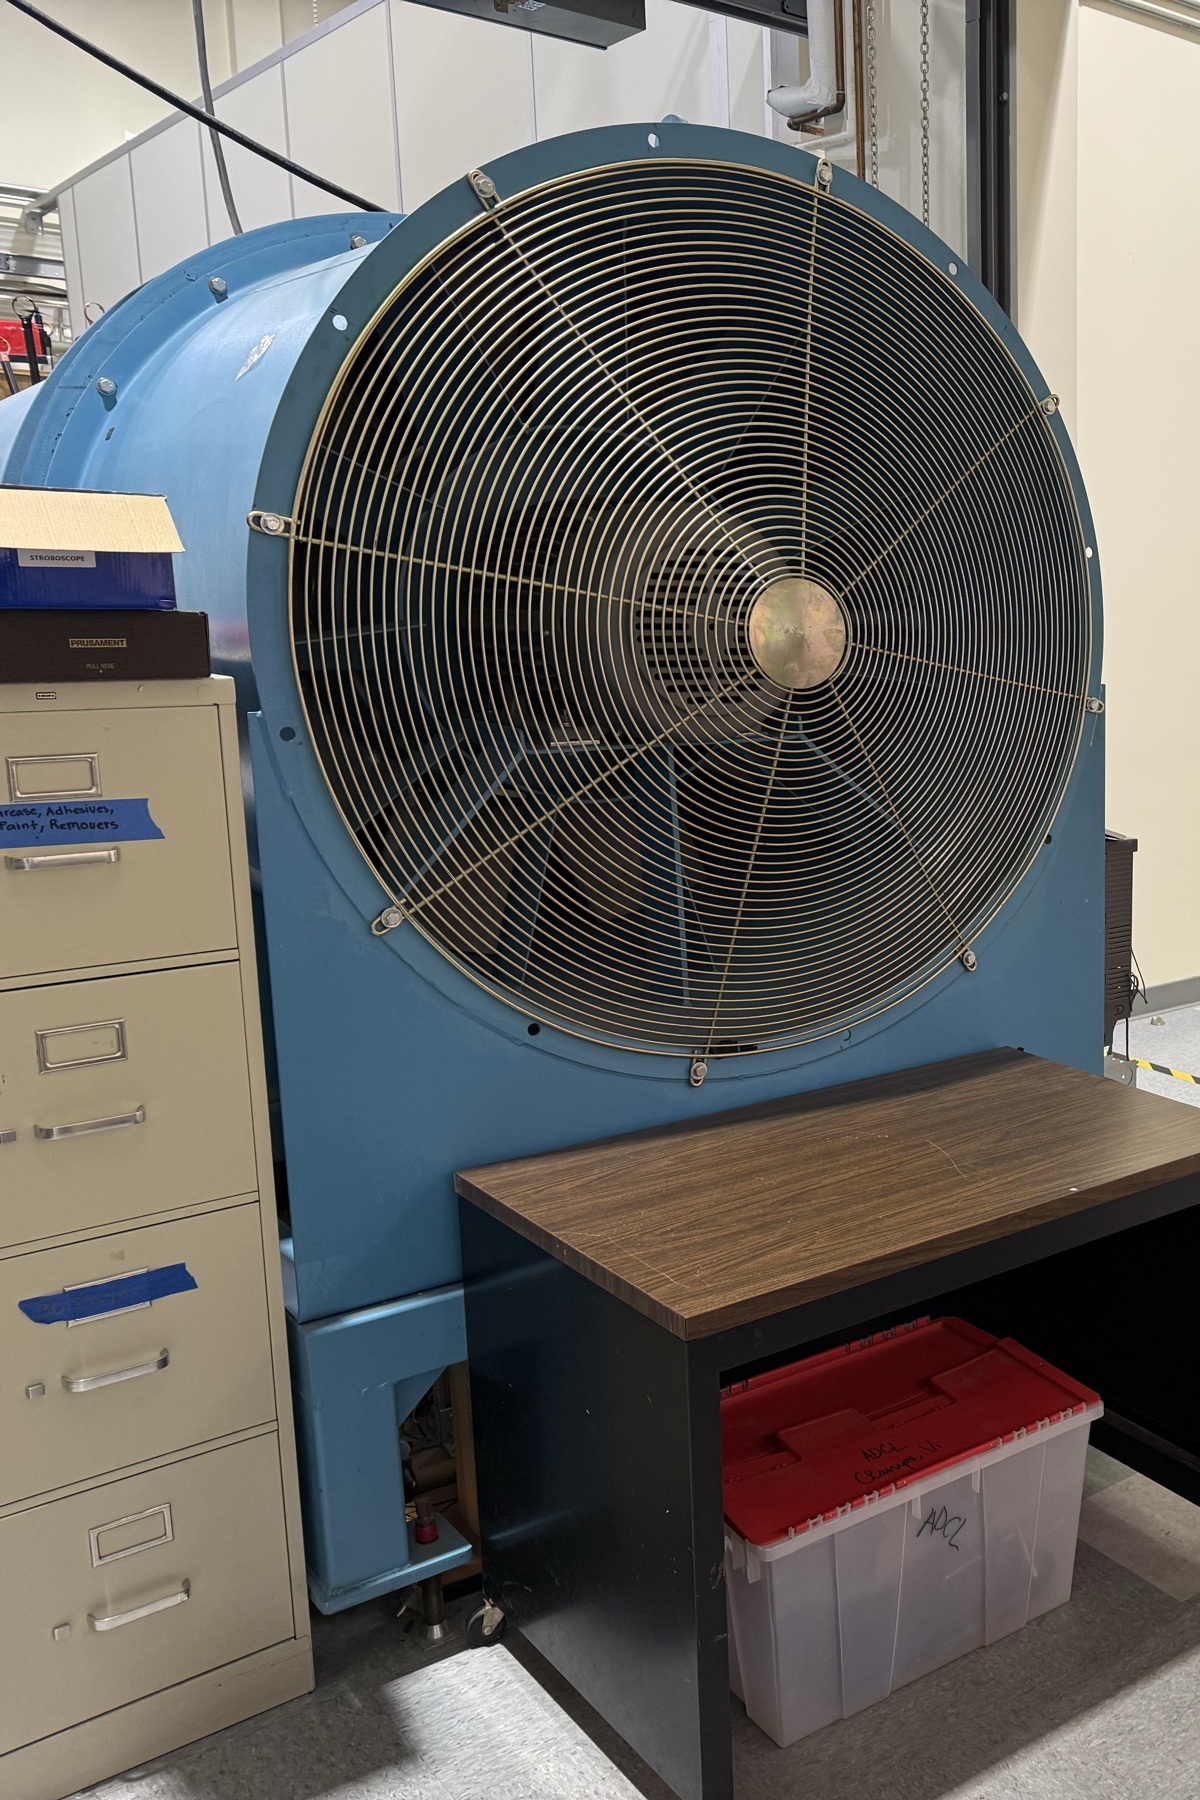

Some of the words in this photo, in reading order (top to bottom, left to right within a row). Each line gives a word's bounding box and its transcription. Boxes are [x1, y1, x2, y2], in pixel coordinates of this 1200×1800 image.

[29, 554, 86, 563] STROBOSCOPE
[70, 638, 126, 648] PRUSAMENT
[46, 803, 115, 817] Adhesives,
[0, 820, 45, 833] Paint,
[50, 818, 119, 831] Removers
[861, 1442, 909, 1462] ADCL
[916, 1505, 967, 1552] ADCL
